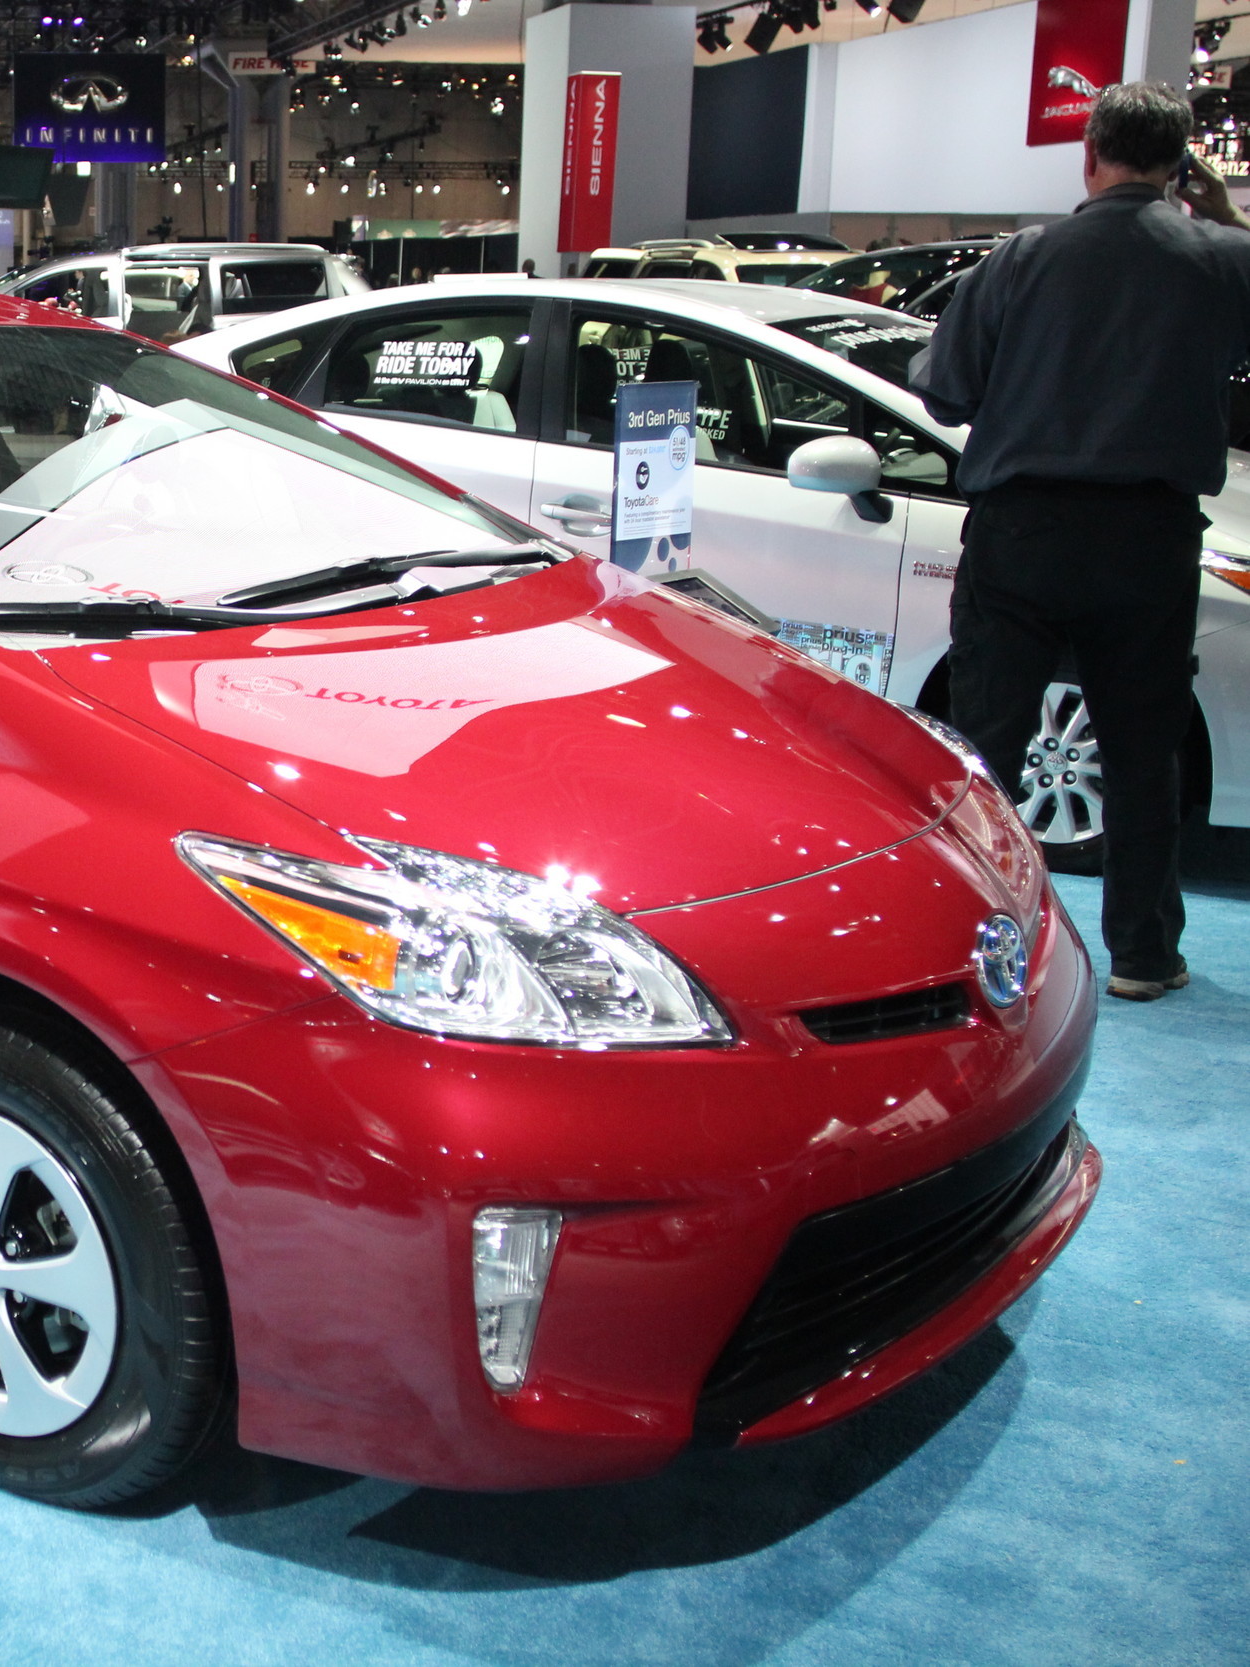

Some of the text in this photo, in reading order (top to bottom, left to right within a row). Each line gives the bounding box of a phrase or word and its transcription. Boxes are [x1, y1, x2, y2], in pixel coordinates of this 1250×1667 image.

[233, 57, 265, 70] FIRE
[26, 127, 154, 143] INFINITI
[590, 79, 607, 196] SIENNA
[382, 341, 476, 357] TAKE ME FOR A
[376, 355, 474, 376] RIDE TODAY
[404, 377, 442, 386] PAVILION
[628, 408, 691, 428] 3rd Gen Prius
[624, 494, 659, 510] ToyotaCare
[801, 635, 822, 645] prius
[823, 627, 865, 644] prius
[821, 641, 863, 655] plug-in
